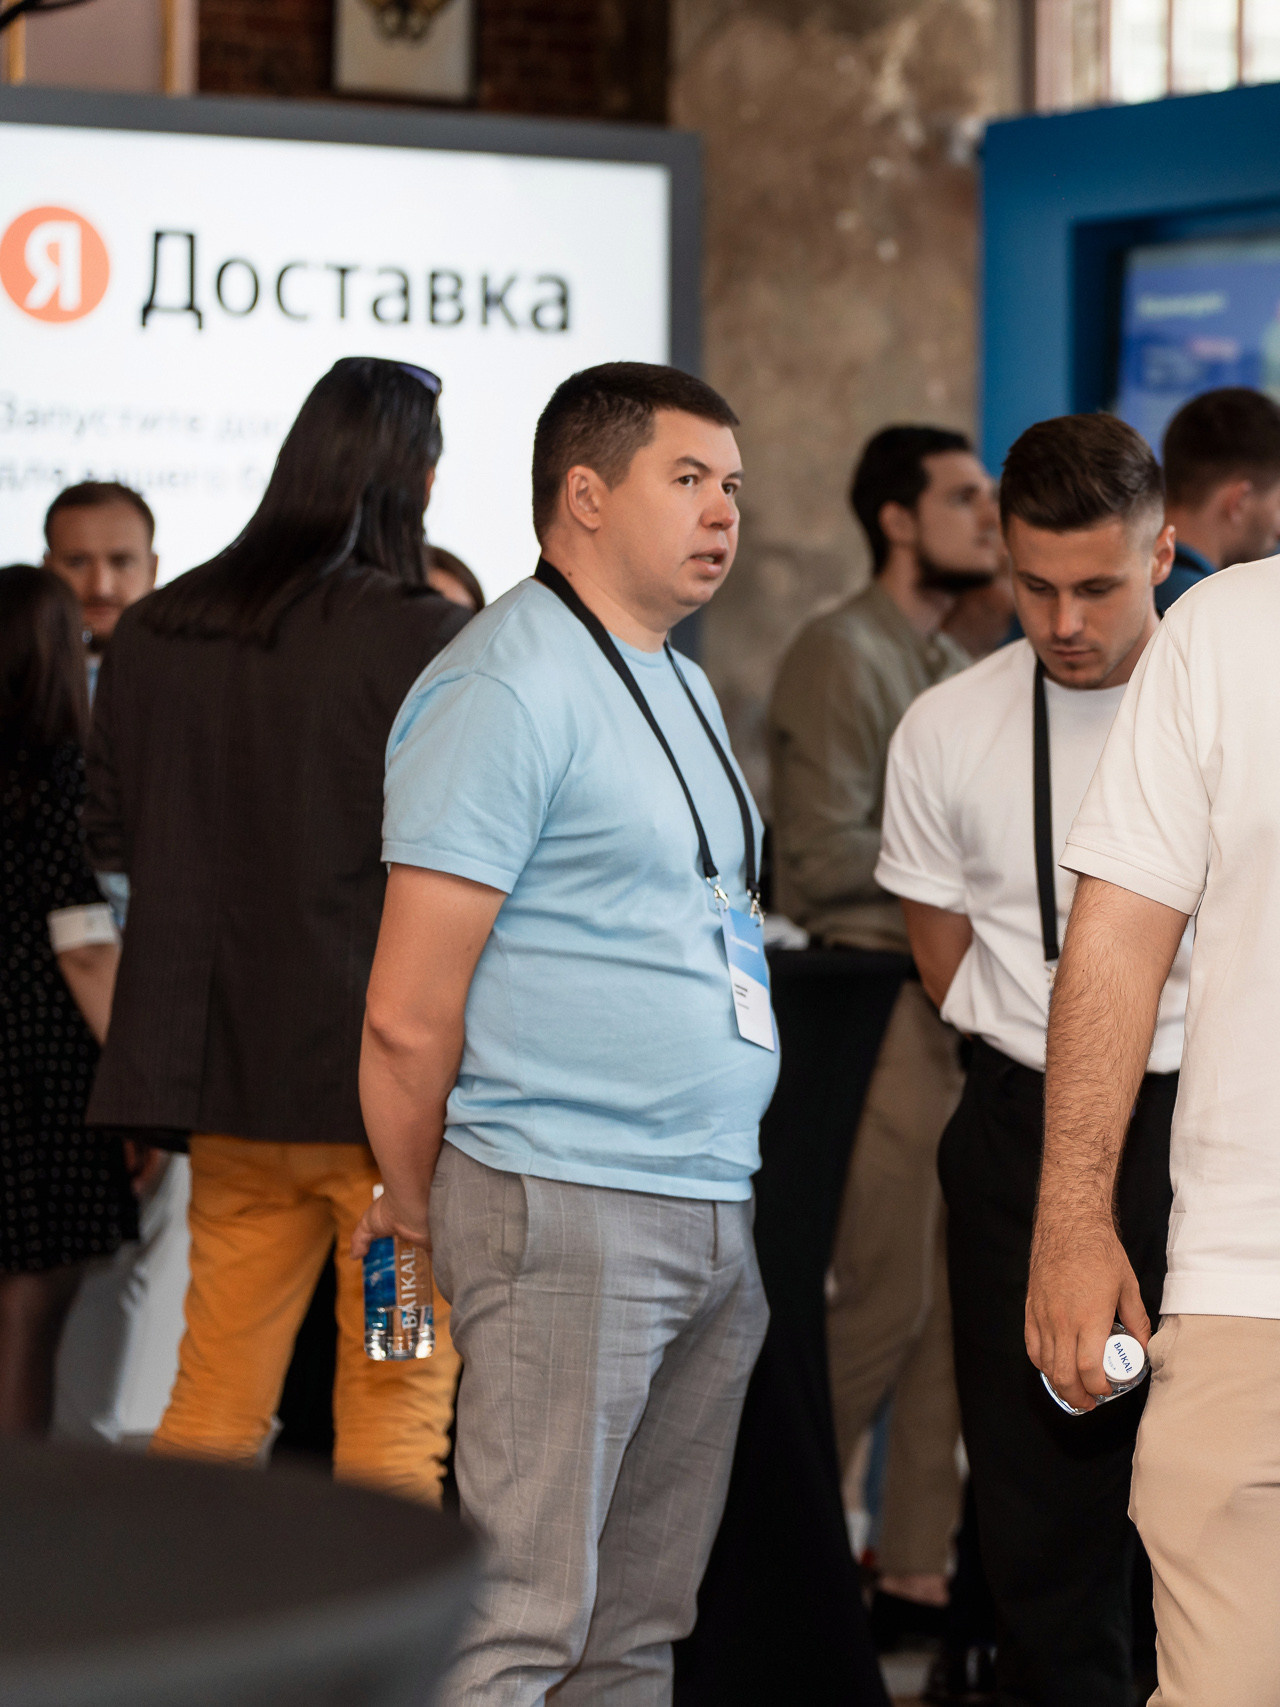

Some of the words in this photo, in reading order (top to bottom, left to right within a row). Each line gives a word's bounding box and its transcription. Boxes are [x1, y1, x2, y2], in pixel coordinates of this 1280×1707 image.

[140, 229, 572, 332] Доставка
[400, 1247, 418, 1330] BAIKAL
[1113, 1342, 1133, 1374] BAIKAL
